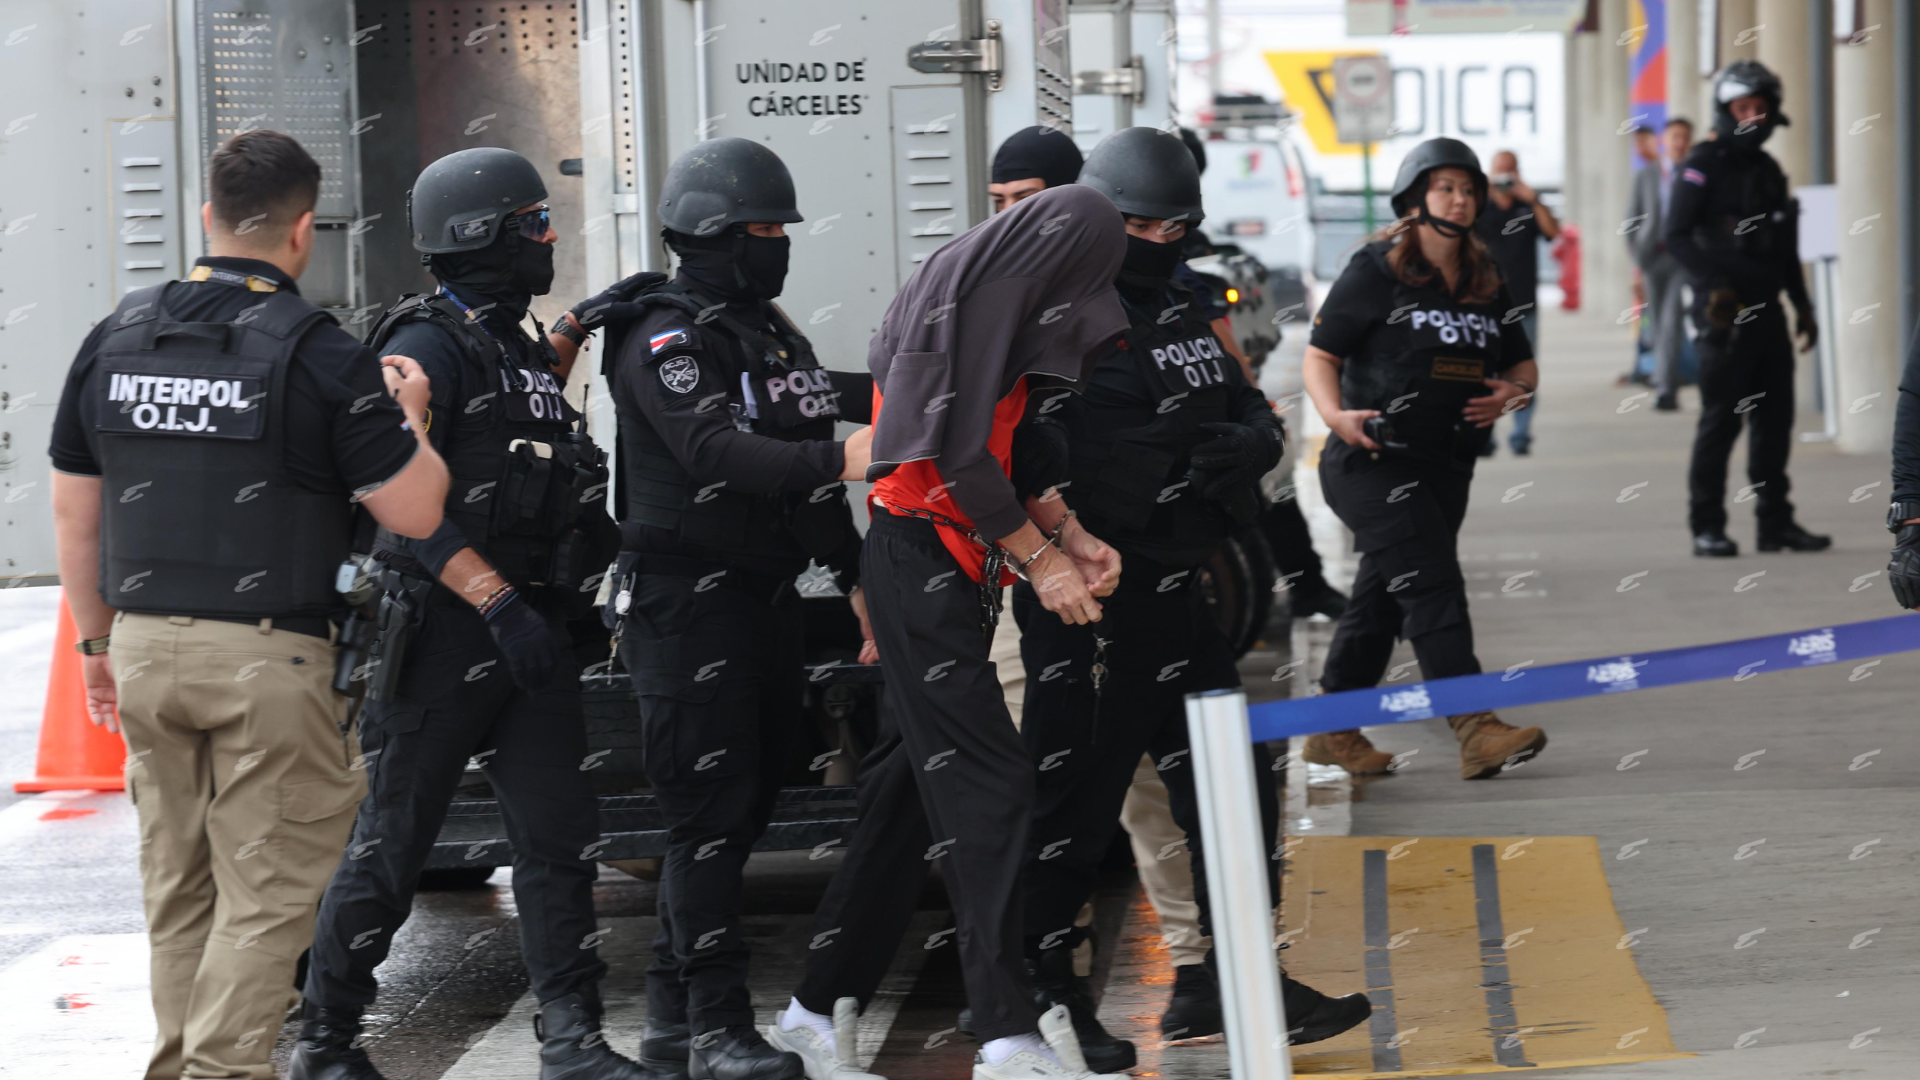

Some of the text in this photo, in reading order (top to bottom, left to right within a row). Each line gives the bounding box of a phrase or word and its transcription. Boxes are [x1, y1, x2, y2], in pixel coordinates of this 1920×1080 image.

[736, 61, 865, 84] UNIDAD DE
[748, 90, 862, 117] CÁRCELES
[1410, 309, 1501, 338] POLICIA
[1150, 336, 1225, 371] POLICIA
[108, 373, 250, 409] INTERPOL
[132, 402, 218, 433] O.I.J.
